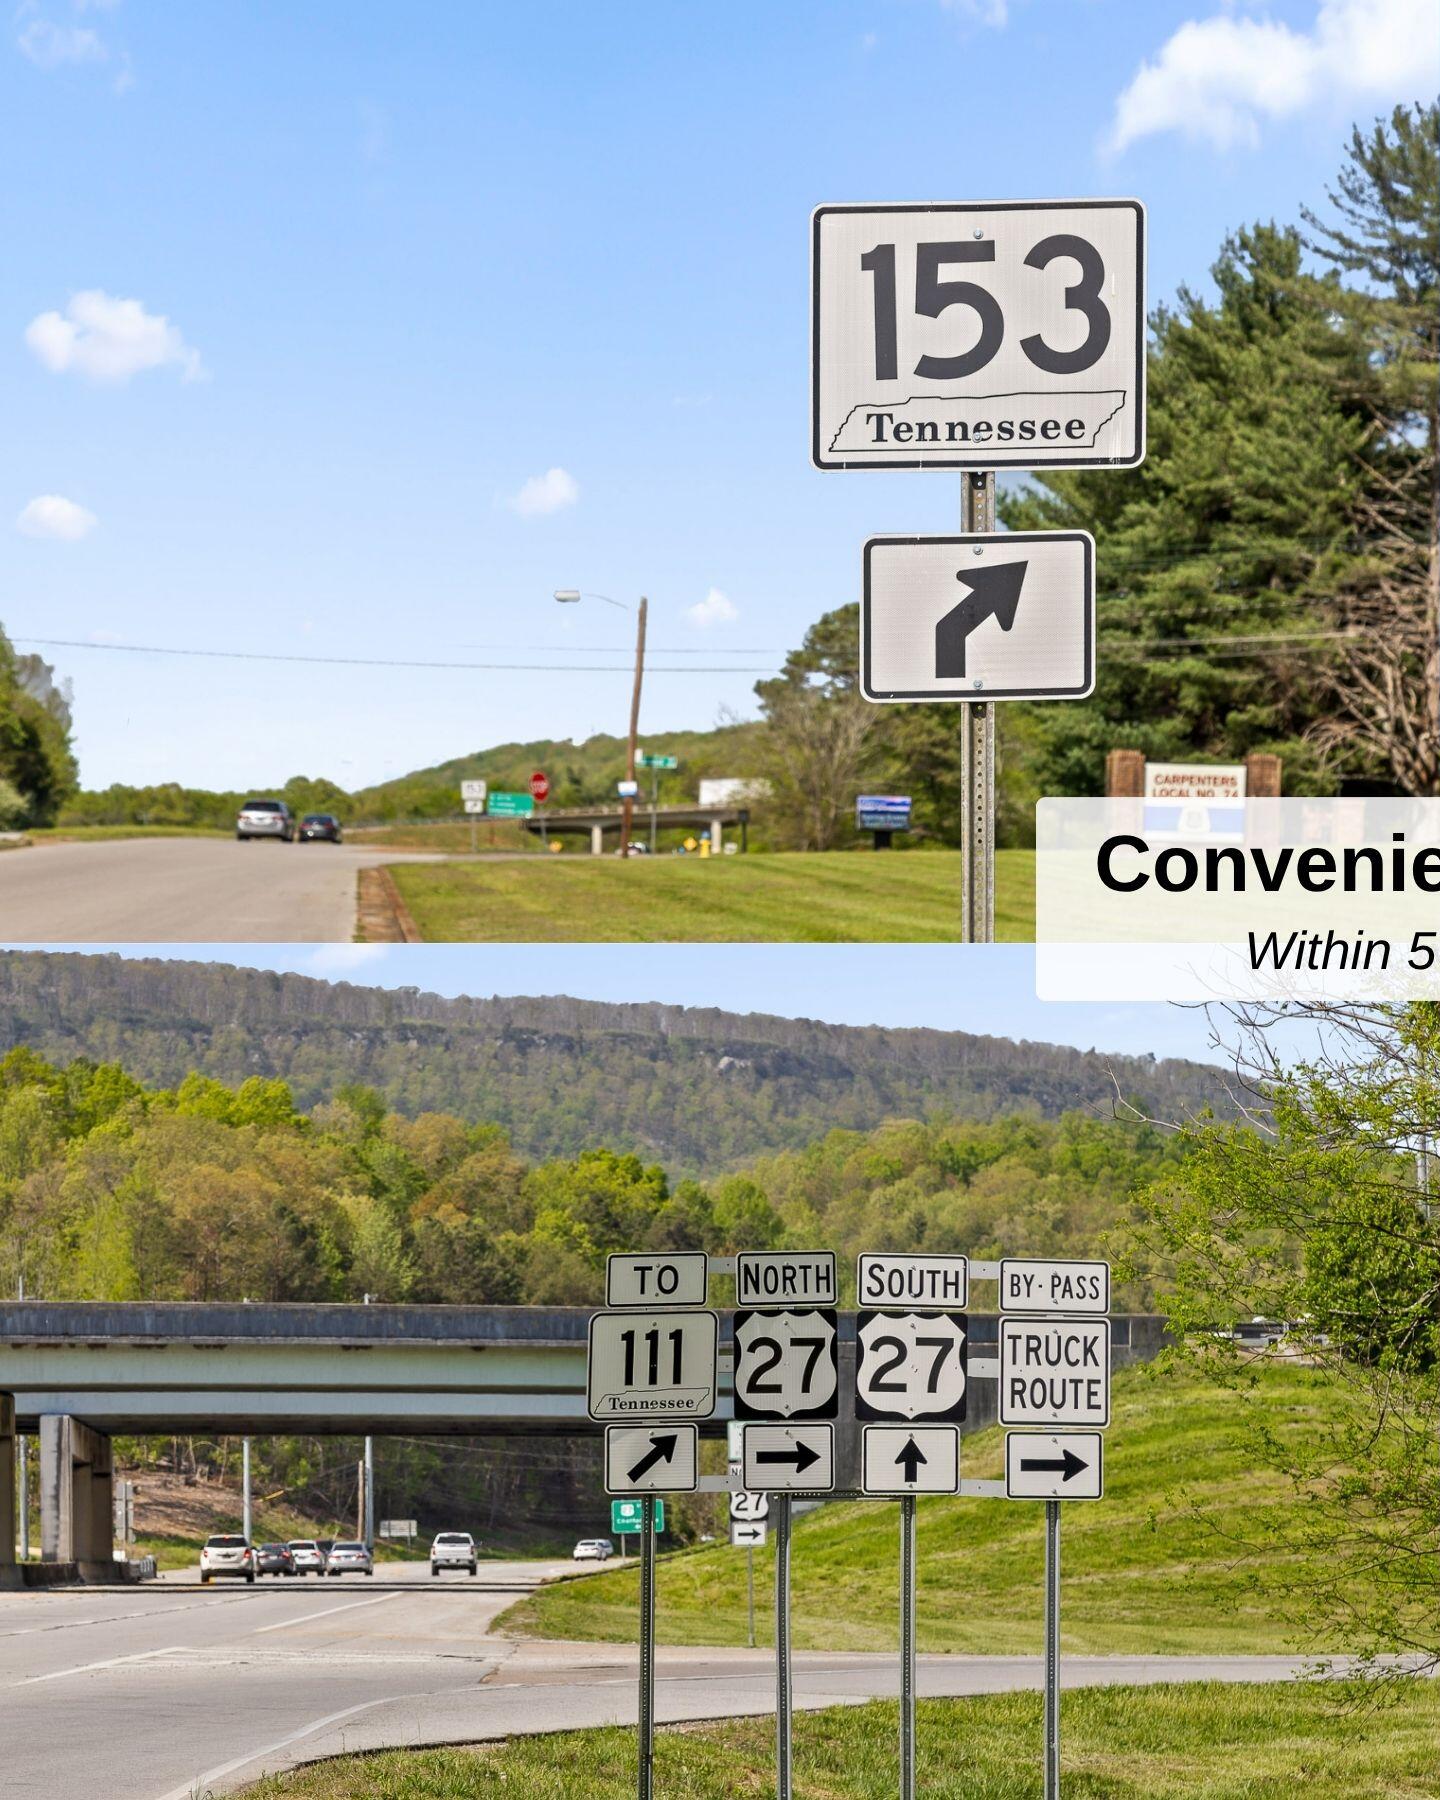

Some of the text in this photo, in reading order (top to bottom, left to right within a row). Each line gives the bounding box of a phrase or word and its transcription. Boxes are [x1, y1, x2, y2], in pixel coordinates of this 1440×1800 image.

[861, 235, 1111, 380] 153
[866, 414, 1085, 442] Tennessee
[1153, 789, 1189, 797] LOCAL
[1155, 775, 1237, 786] CARPENTERS
[634, 1265, 678, 1296] TO
[744, 1263, 830, 1294] NORTH
[867, 1264, 959, 1298] SOUTH
[621, 1328, 683, 1387] 111
[746, 1337, 825, 1393] 27
[869, 1336, 954, 1393] 27
[1008, 1335, 1099, 1366] TRUCK
[608, 1396, 695, 1410] Tennessee
[1011, 1378, 1101, 1409] ROUTE
[734, 1491, 764, 1512] 27
